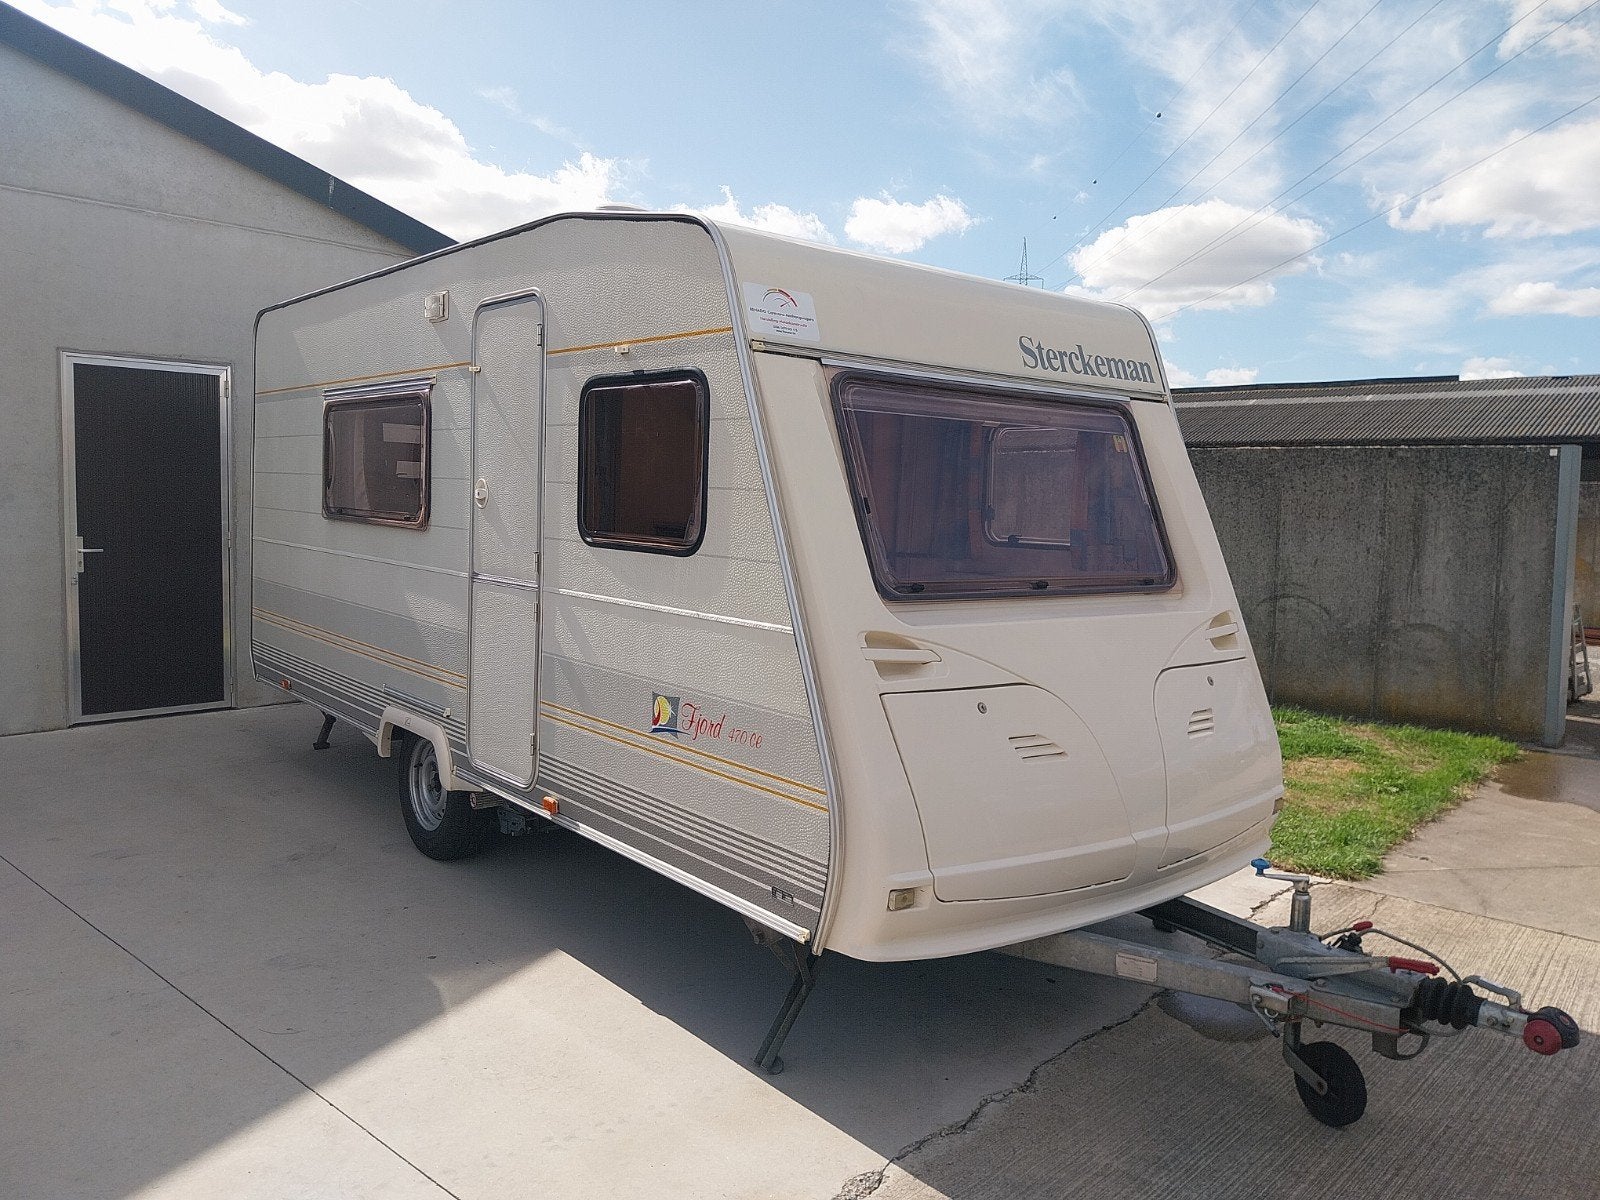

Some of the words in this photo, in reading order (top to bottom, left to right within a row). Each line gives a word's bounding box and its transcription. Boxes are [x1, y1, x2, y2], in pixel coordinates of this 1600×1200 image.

[1018, 335, 1156, 384] Sterckeman
[681, 702, 726, 741] Fjord
[728, 728, 748, 745] 470
